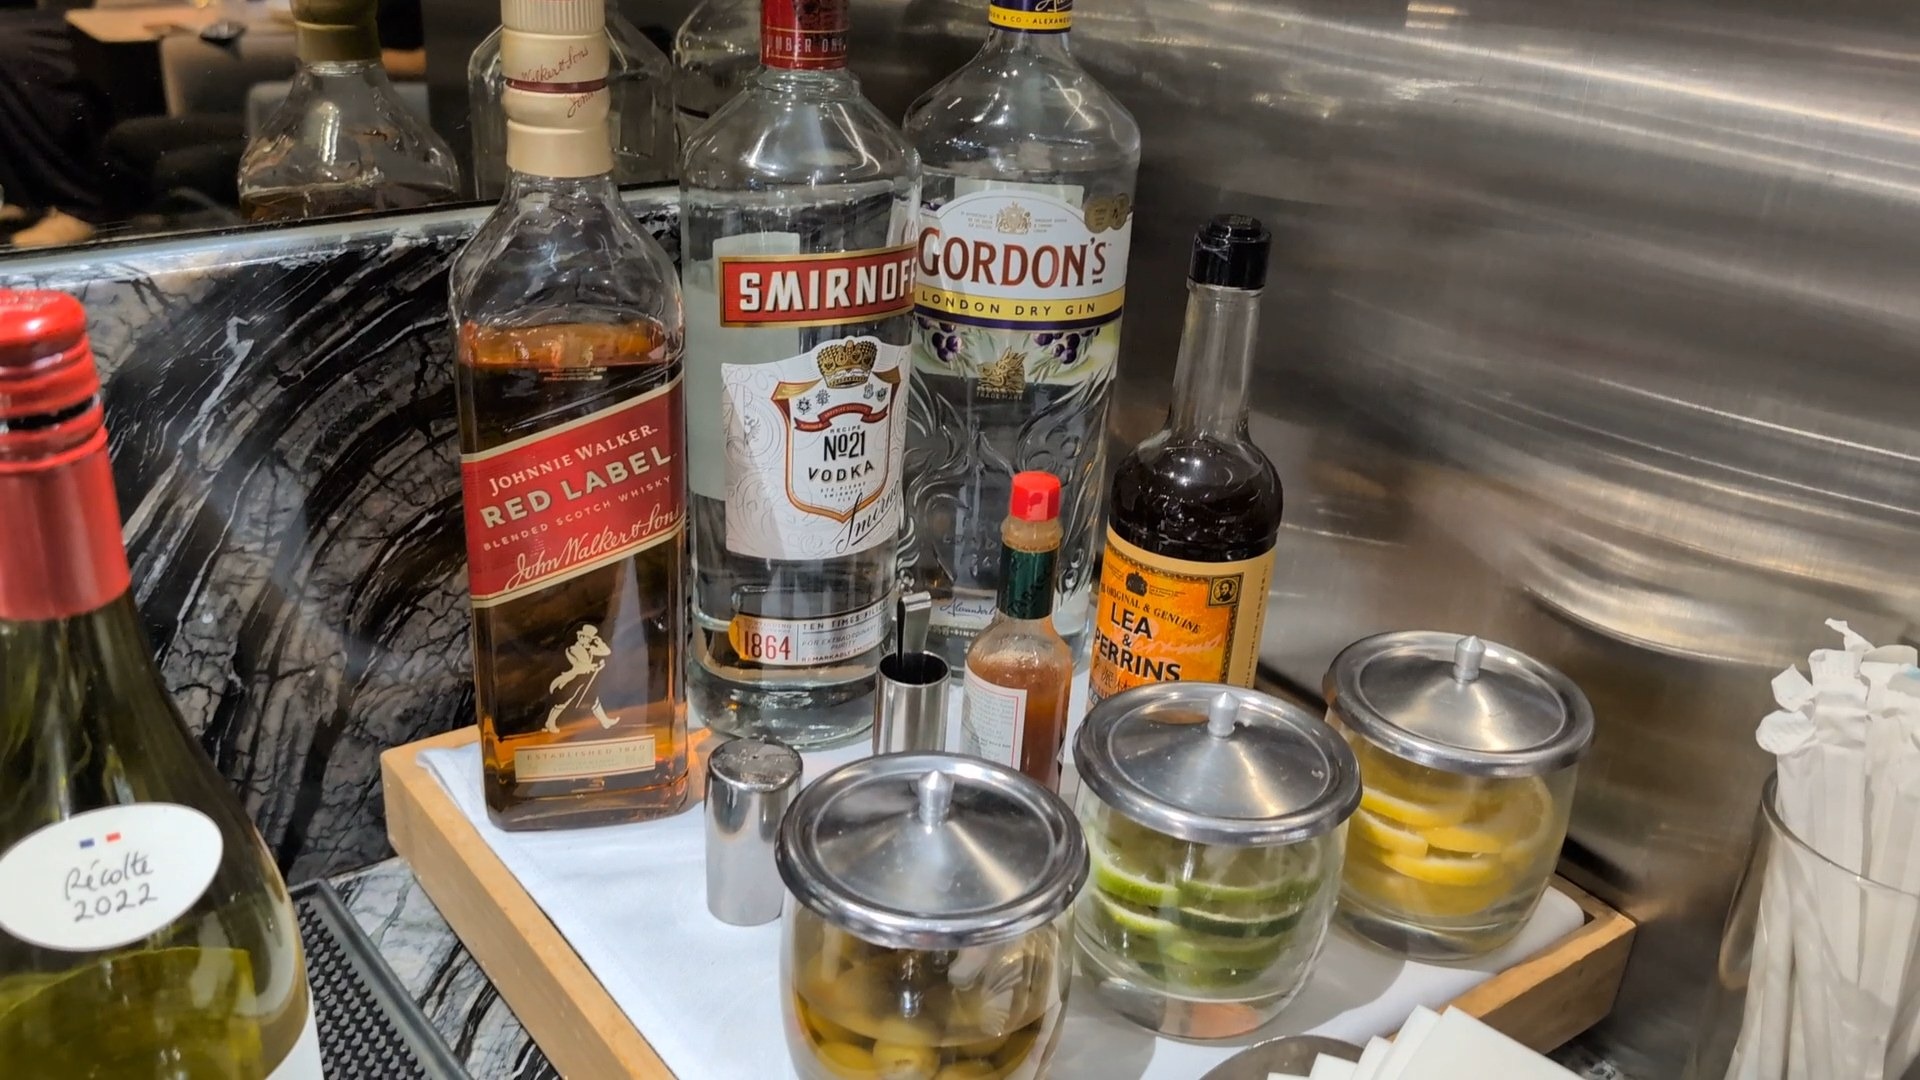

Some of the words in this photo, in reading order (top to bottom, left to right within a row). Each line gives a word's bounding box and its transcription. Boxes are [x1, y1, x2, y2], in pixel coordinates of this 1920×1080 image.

[918, 227, 1106, 288] GORDON'S
[739, 256, 917, 312] SMIRNOFF
[921, 290, 1000, 315] LONDON
[1015, 306, 1052, 317] DRY
[1065, 302, 1096, 316] GIN
[829, 424, 862, 434] RECIPE
[489, 455, 573, 497] JOHNNIE
[575, 424, 653, 461] WALKER
[808, 460, 874, 482] VODKA
[480, 490, 552, 528] RED
[560, 446, 671, 501] LABEL
[483, 523, 549, 551] BLENDED
[556, 500, 611, 526] SCOTCH
[618, 475, 671, 502] WHISKY
[563, 525, 630, 566] Walker
[642, 502, 680, 536] Sons
[832, 614, 861, 628] TIMES
[1106, 584, 1140, 609] ORIGINAL
[1143, 603, 1151, 613] &
[1153, 607, 1201, 634] GENUINE
[1111, 601, 1153, 639] LEA
[744, 631, 791, 660] 1864
[1094, 627, 1181, 681] PERRINS
[1122, 633, 1133, 649] &
[526, 748, 612, 761] ESTABLISHED
[64, 851, 154, 901] Récolte
[73, 883, 158, 923] 2022
